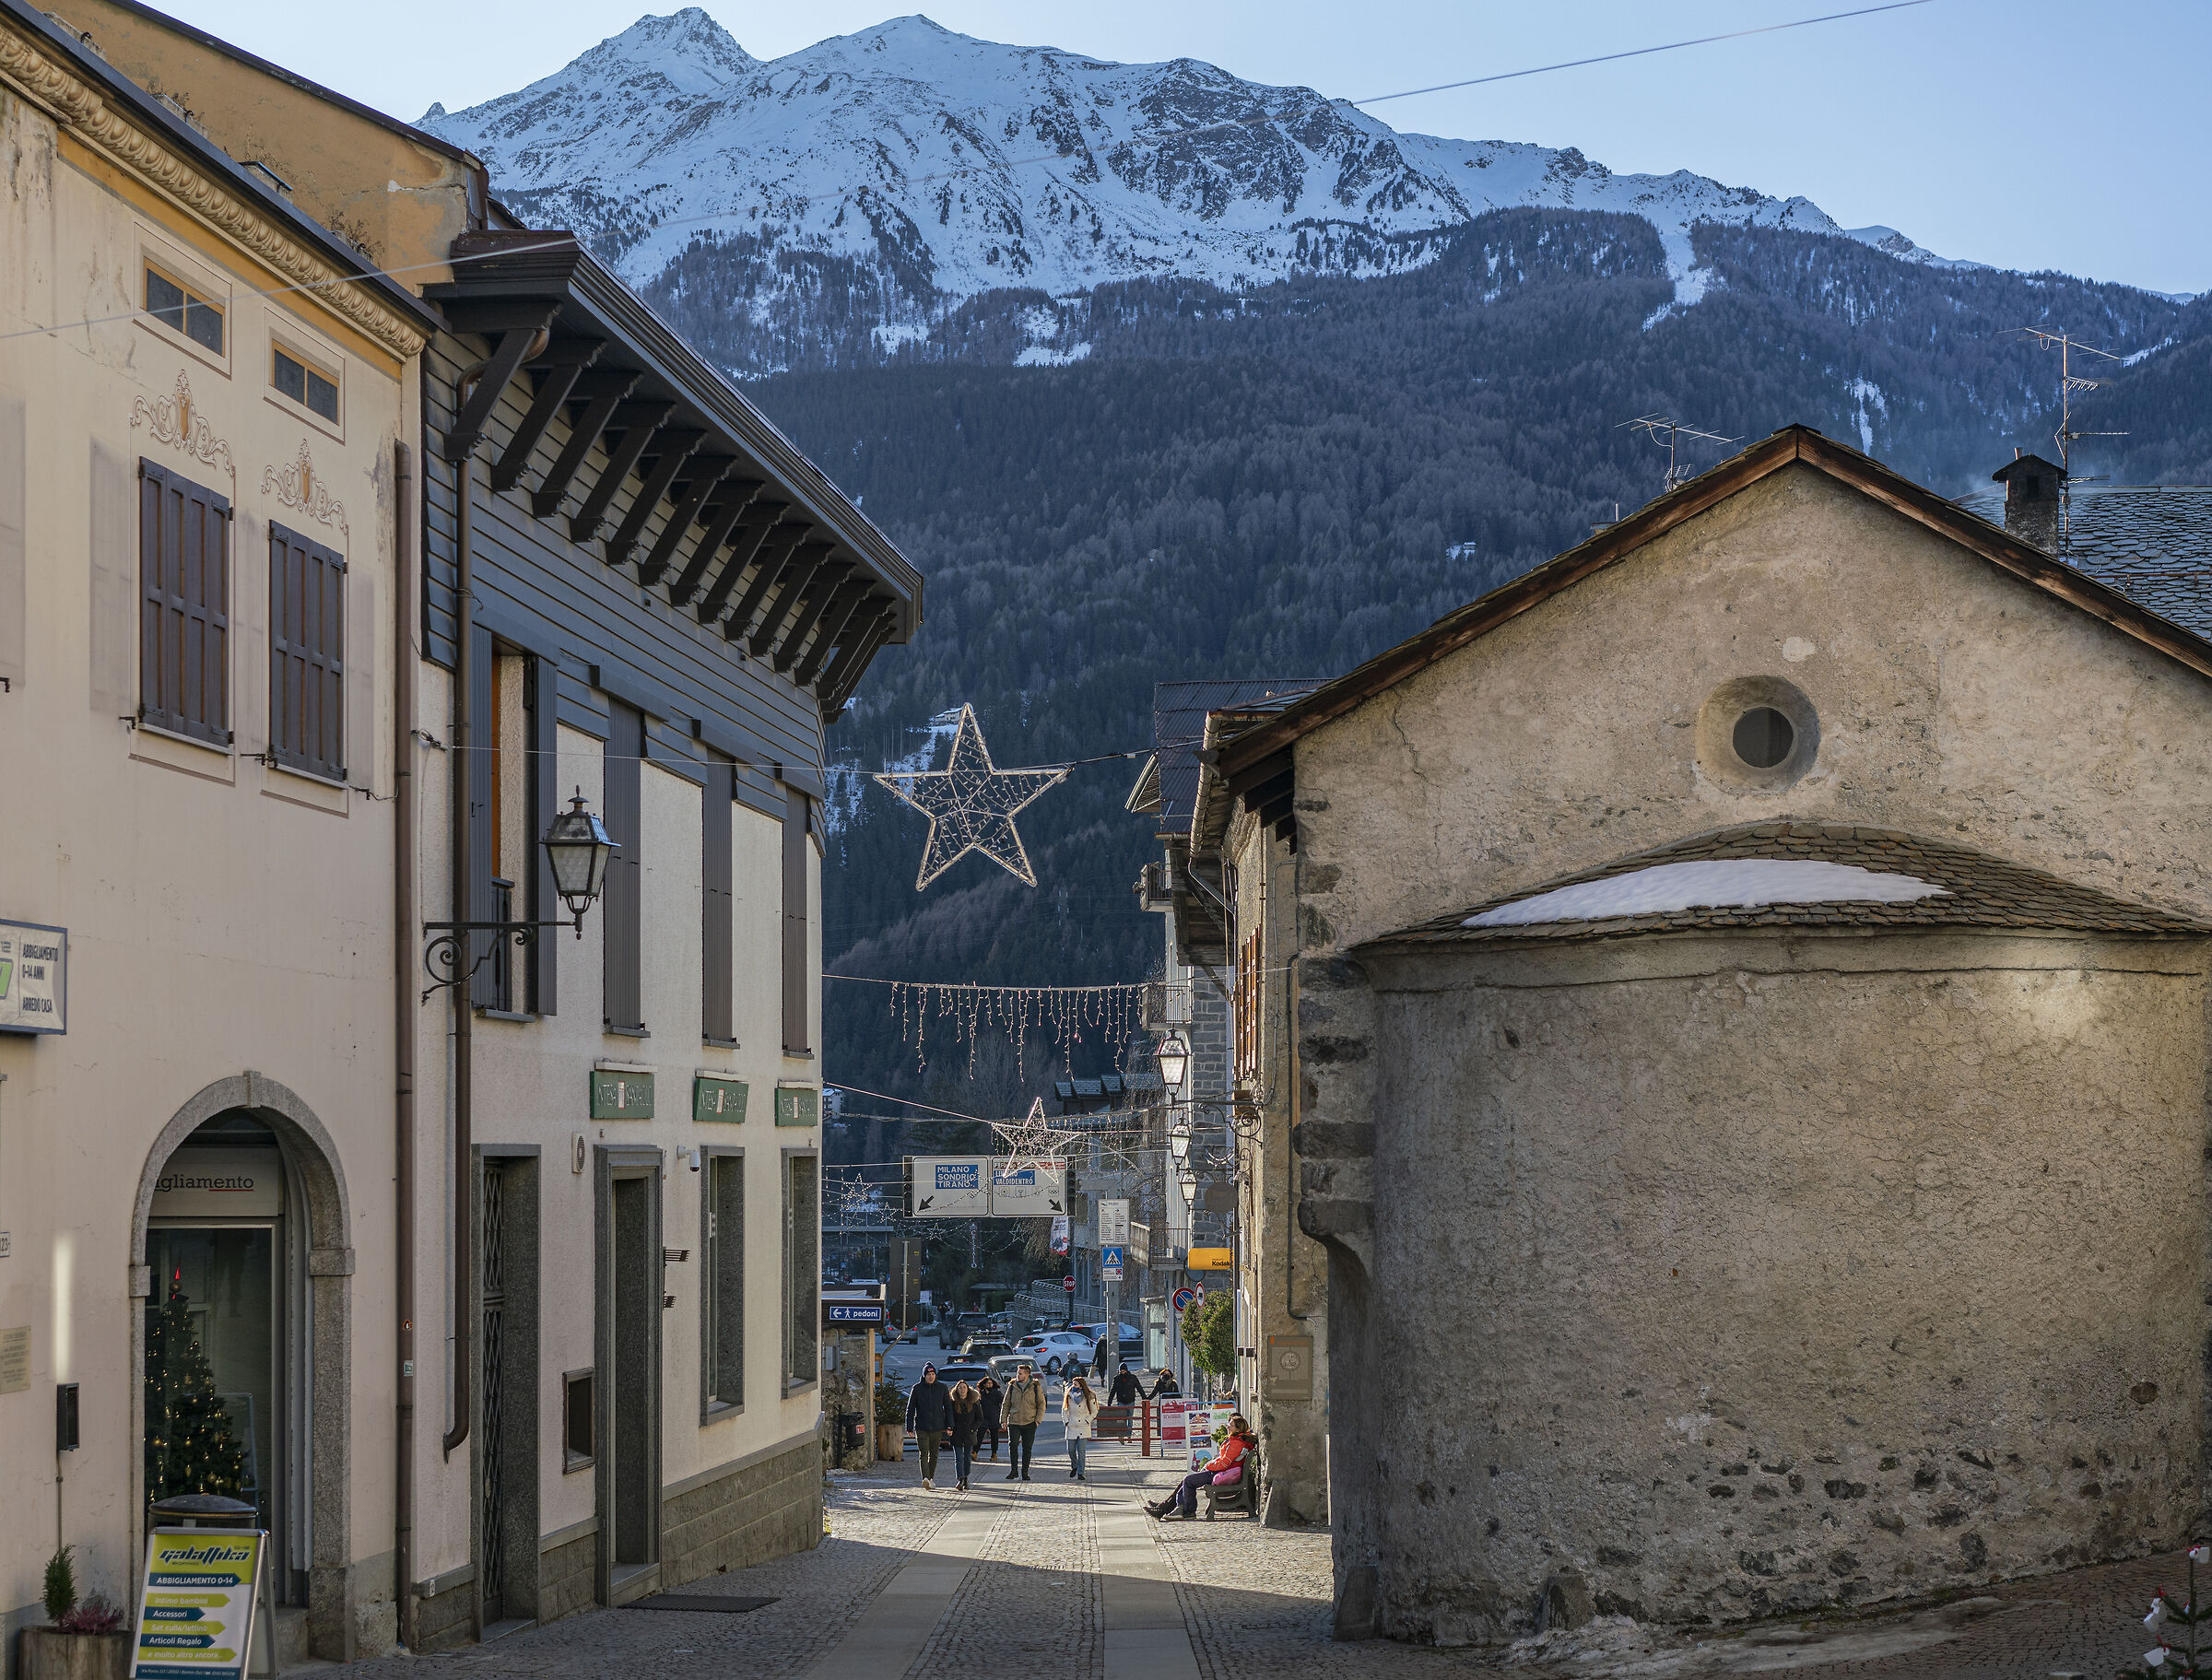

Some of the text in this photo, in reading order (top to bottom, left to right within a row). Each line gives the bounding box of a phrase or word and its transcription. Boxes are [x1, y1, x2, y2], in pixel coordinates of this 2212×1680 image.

[22, 944, 59, 962] ABBIGLIAMENTO
[22, 964, 45, 981] 0-14 ANNI
[22, 997, 53, 1014] ARREDO CASA
[853, 1310, 878, 1318] pedoni
[154, 1596, 208, 1604] Intimo bambini
[153, 1610, 188, 1618] Accessori
[177, 1637, 203, 1646] Regalo
